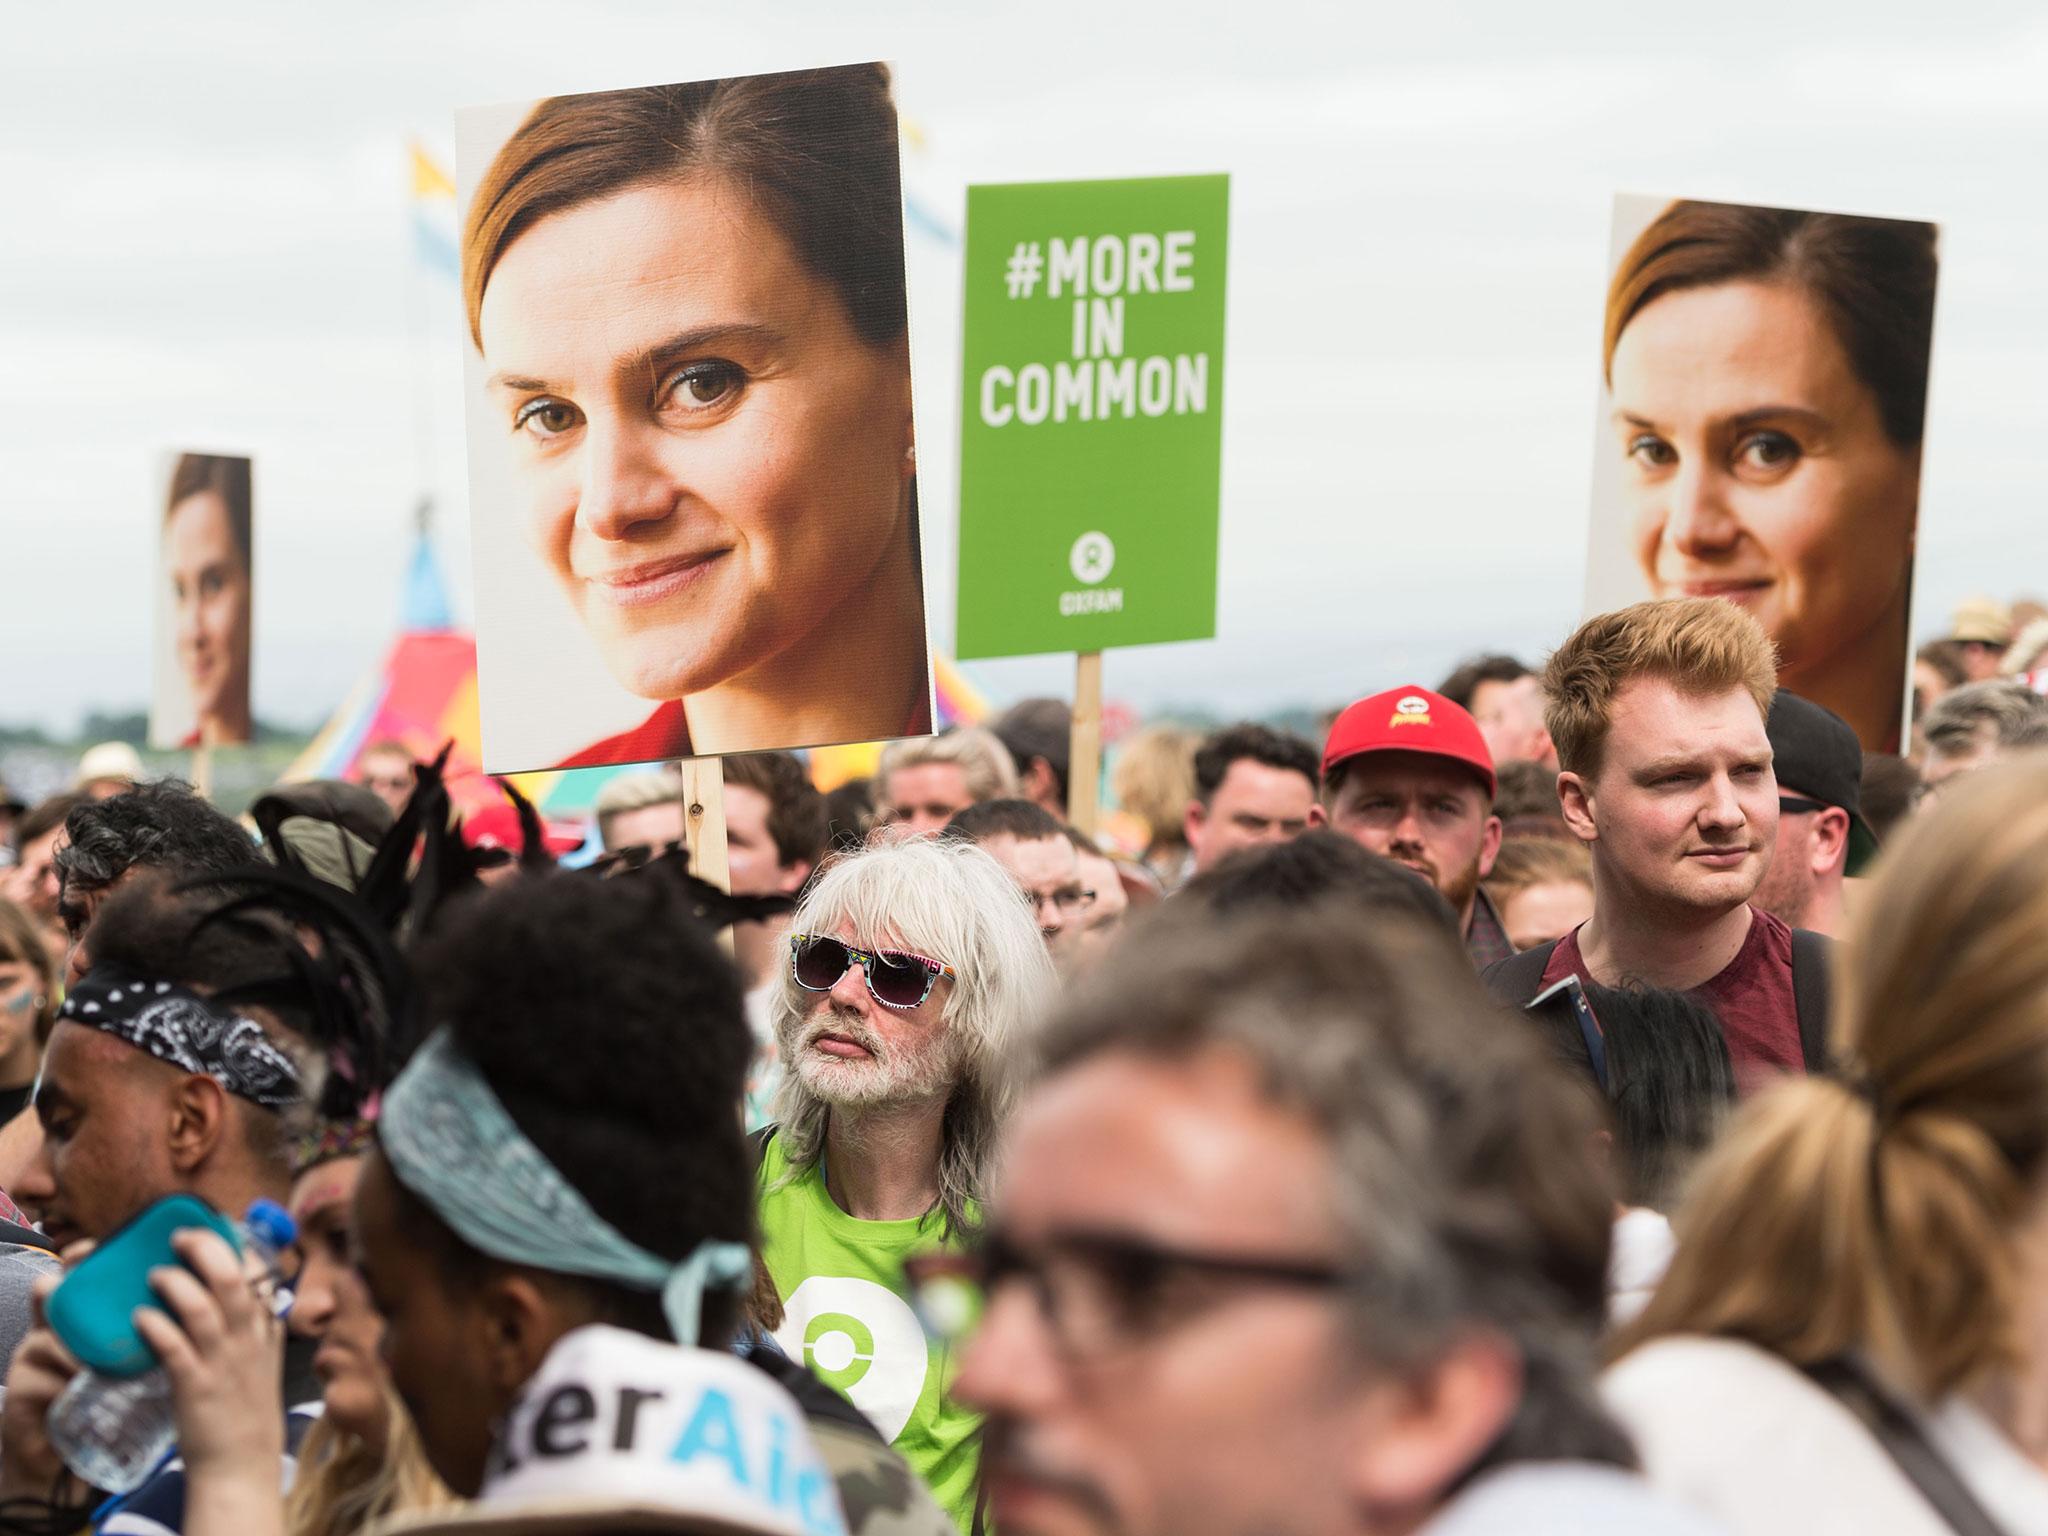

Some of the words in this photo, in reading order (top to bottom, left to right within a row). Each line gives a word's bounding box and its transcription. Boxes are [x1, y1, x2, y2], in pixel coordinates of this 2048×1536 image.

[1005, 230, 1196, 299] #MORE
[1072, 296, 1125, 360] IN
[980, 352, 1209, 428] COMMON
[1059, 588, 1124, 616] OXFAM
